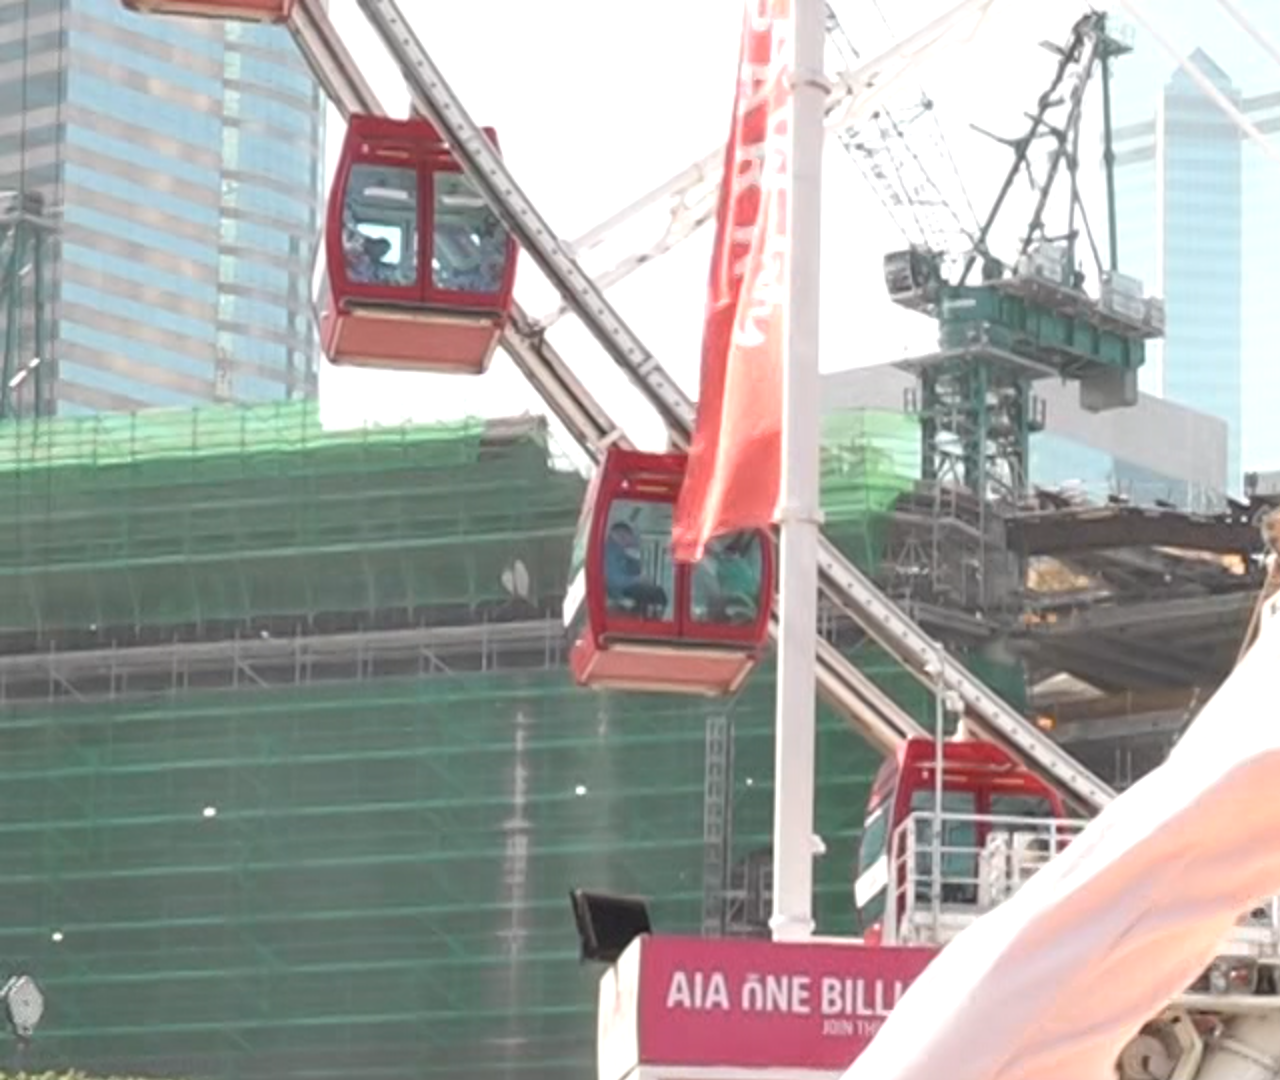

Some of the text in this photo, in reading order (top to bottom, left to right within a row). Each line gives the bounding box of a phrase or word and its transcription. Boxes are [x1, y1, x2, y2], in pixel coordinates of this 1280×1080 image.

[666, 971, 730, 1011] AIA
[822, 1019, 880, 1038] JOIN TH
